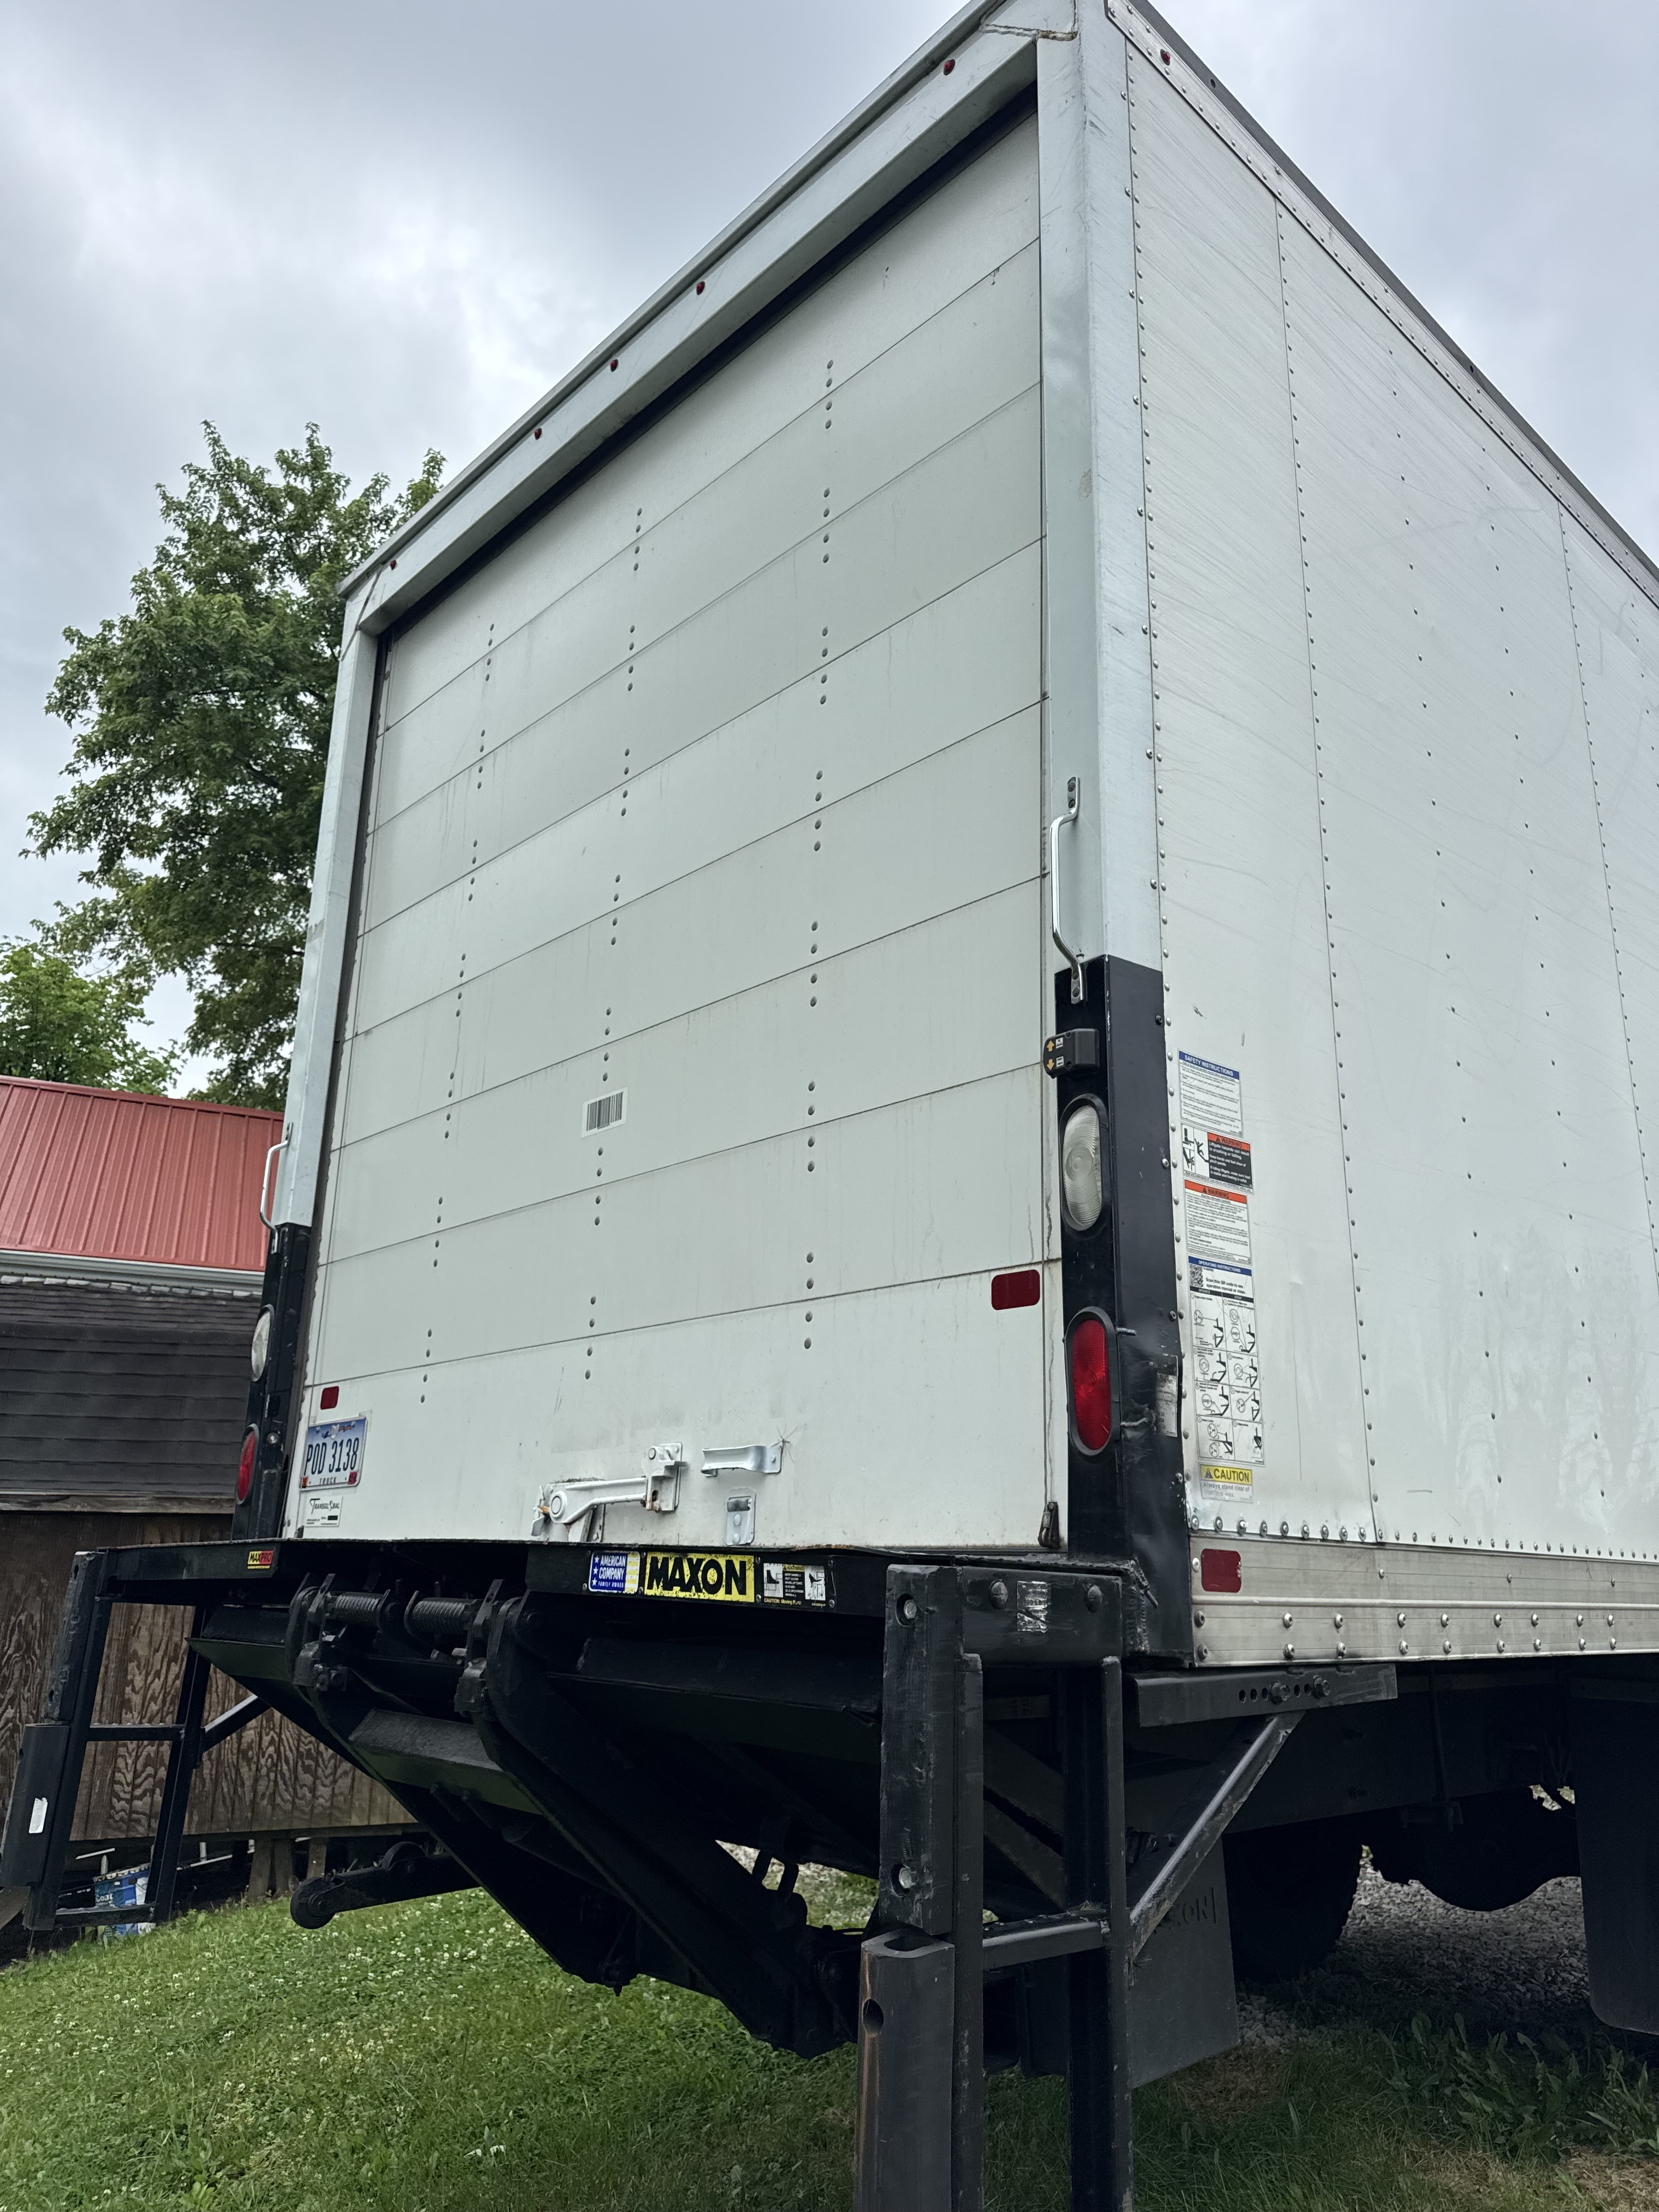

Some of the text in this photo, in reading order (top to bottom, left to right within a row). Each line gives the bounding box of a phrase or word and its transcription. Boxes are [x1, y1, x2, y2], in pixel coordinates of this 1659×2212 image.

[1184, 1054, 1234, 1076] SAFETY INSTRUCTIONS
[1221, 1137, 1243, 1148] WARNING
[1207, 1188, 1229, 1199] WARNING
[1217, 1265, 1241, 1273] INSTRUCTIONS
[304, 1437, 360, 1476] POD 3138
[319, 1477, 337, 1485] TRUCK
[1214, 1469, 1249, 1482] CAUTION
[1203, 1482, 1221, 1490] Always
[249, 1552, 273, 1563] MAXPRO
[600, 1555, 626, 1567] AMERICAN
[599, 1567, 625, 1581] COMPANY
[646, 1556, 748, 1595] MAXON
